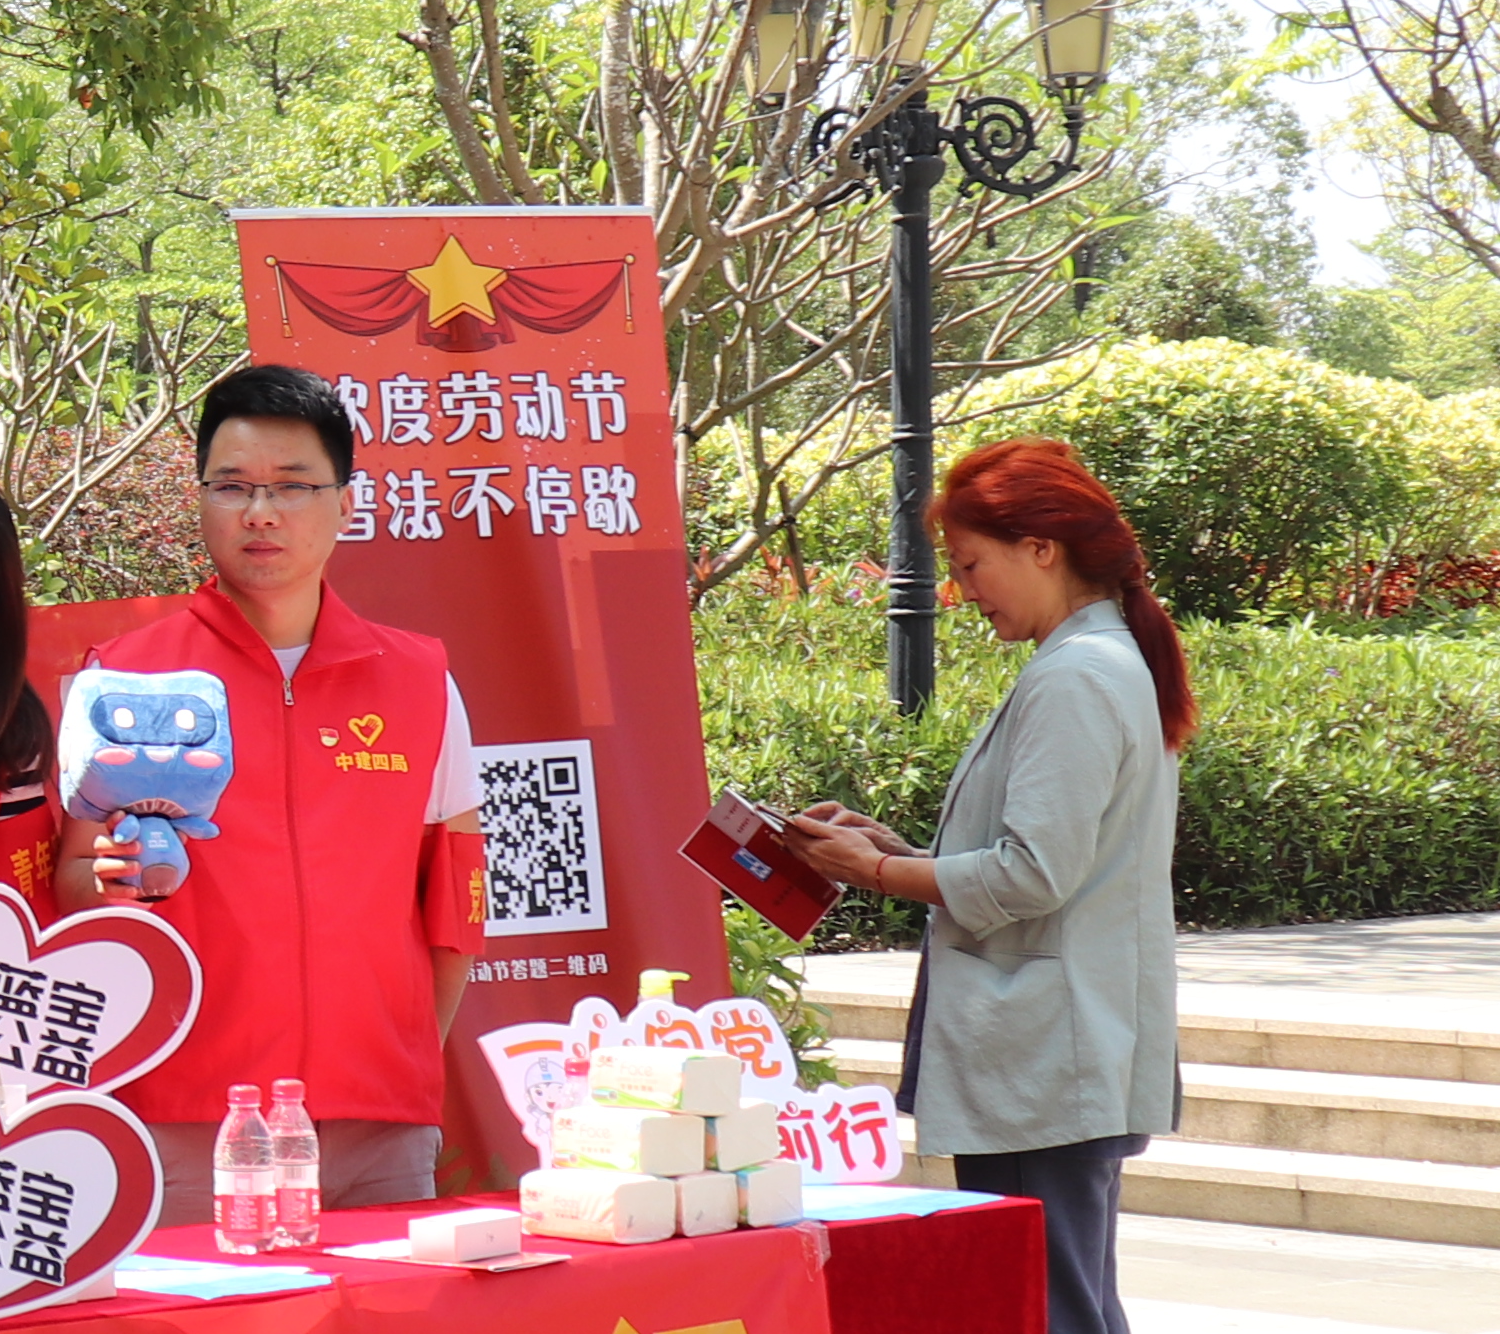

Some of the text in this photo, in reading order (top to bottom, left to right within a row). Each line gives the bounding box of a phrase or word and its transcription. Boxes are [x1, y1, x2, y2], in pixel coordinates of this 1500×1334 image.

[333, 370, 627, 446] 欢度劳动节
[336, 465, 642, 543] 普法不停歇
[335, 750, 409, 774] 中建四局
